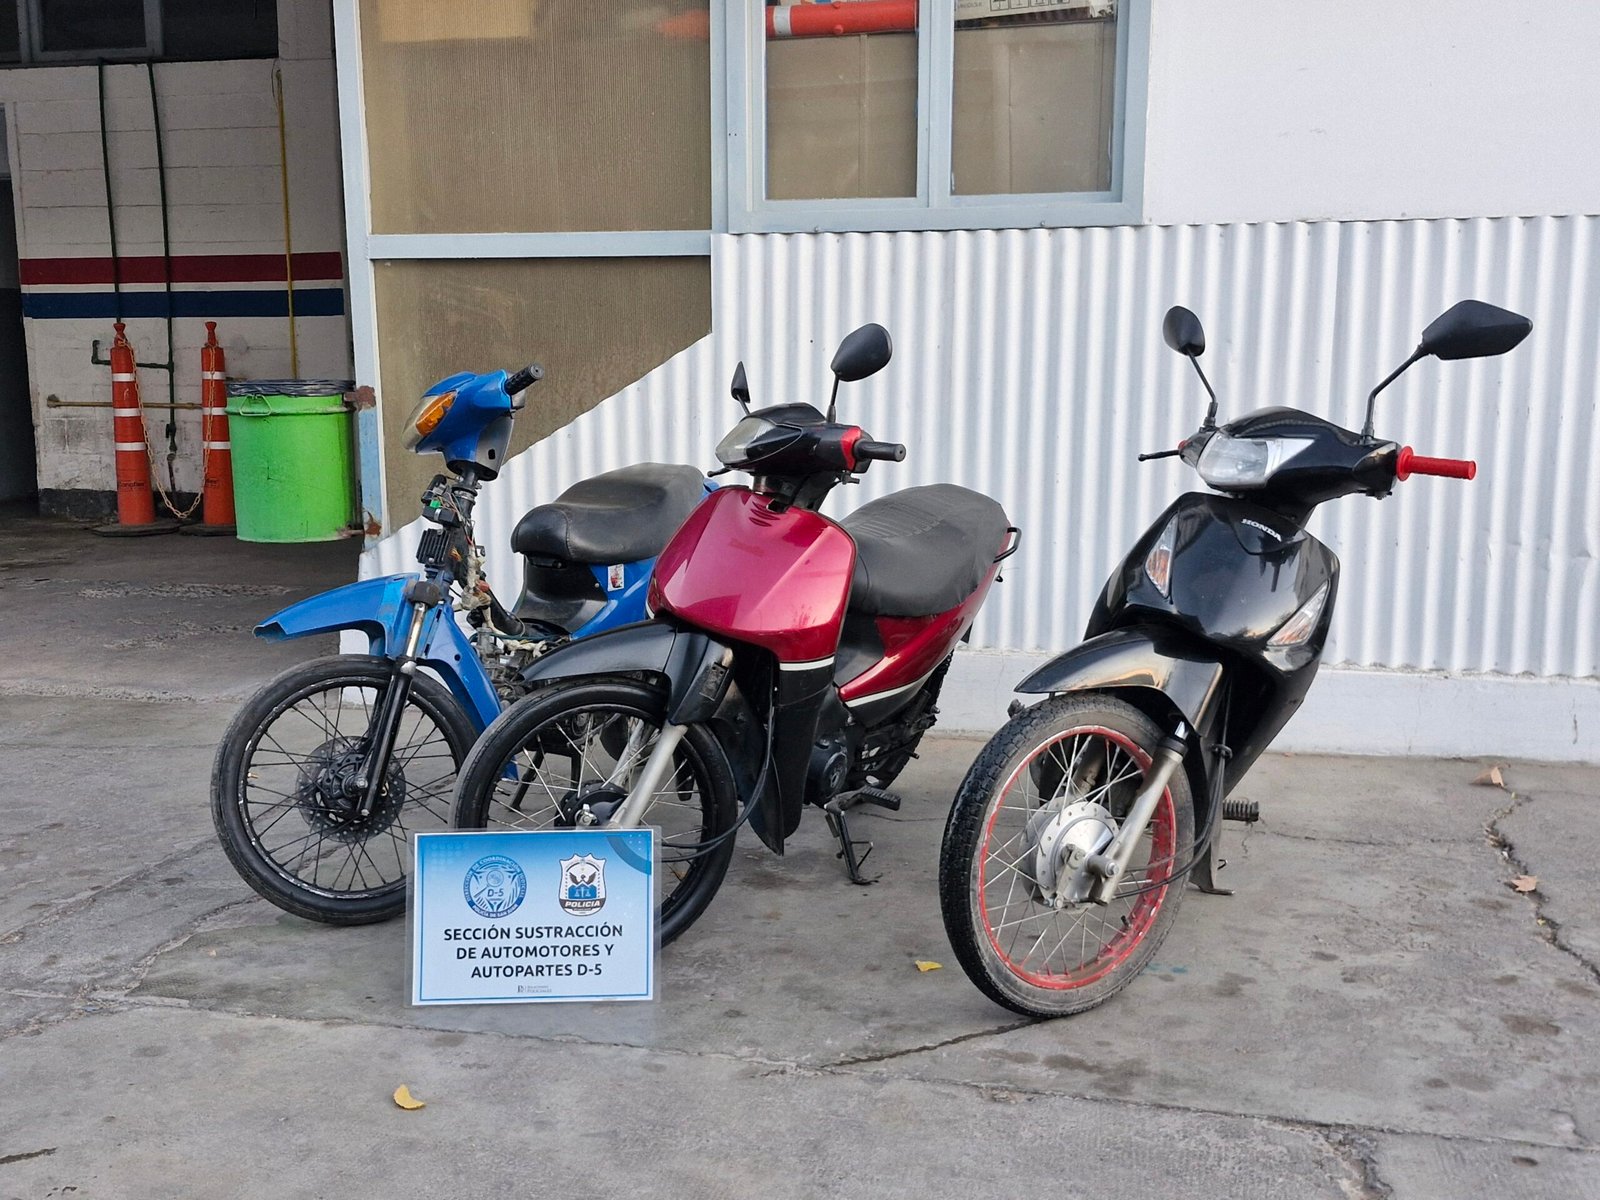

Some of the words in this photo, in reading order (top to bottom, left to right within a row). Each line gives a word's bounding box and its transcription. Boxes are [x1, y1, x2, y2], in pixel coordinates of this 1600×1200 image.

[1241, 518, 1282, 542] HONDA
[487, 888, 504, 897] D-5
[444, 924, 511, 941] SECCIÓN
[515, 921, 623, 940] SUSTRACCIÓN
[456, 947, 477, 960] DE
[480, 944, 601, 959] AUTOMOTORES
[604, 943, 615, 956] Y
[471, 964, 573, 978] AUTOPARTES
[577, 963, 602, 976] D-5
